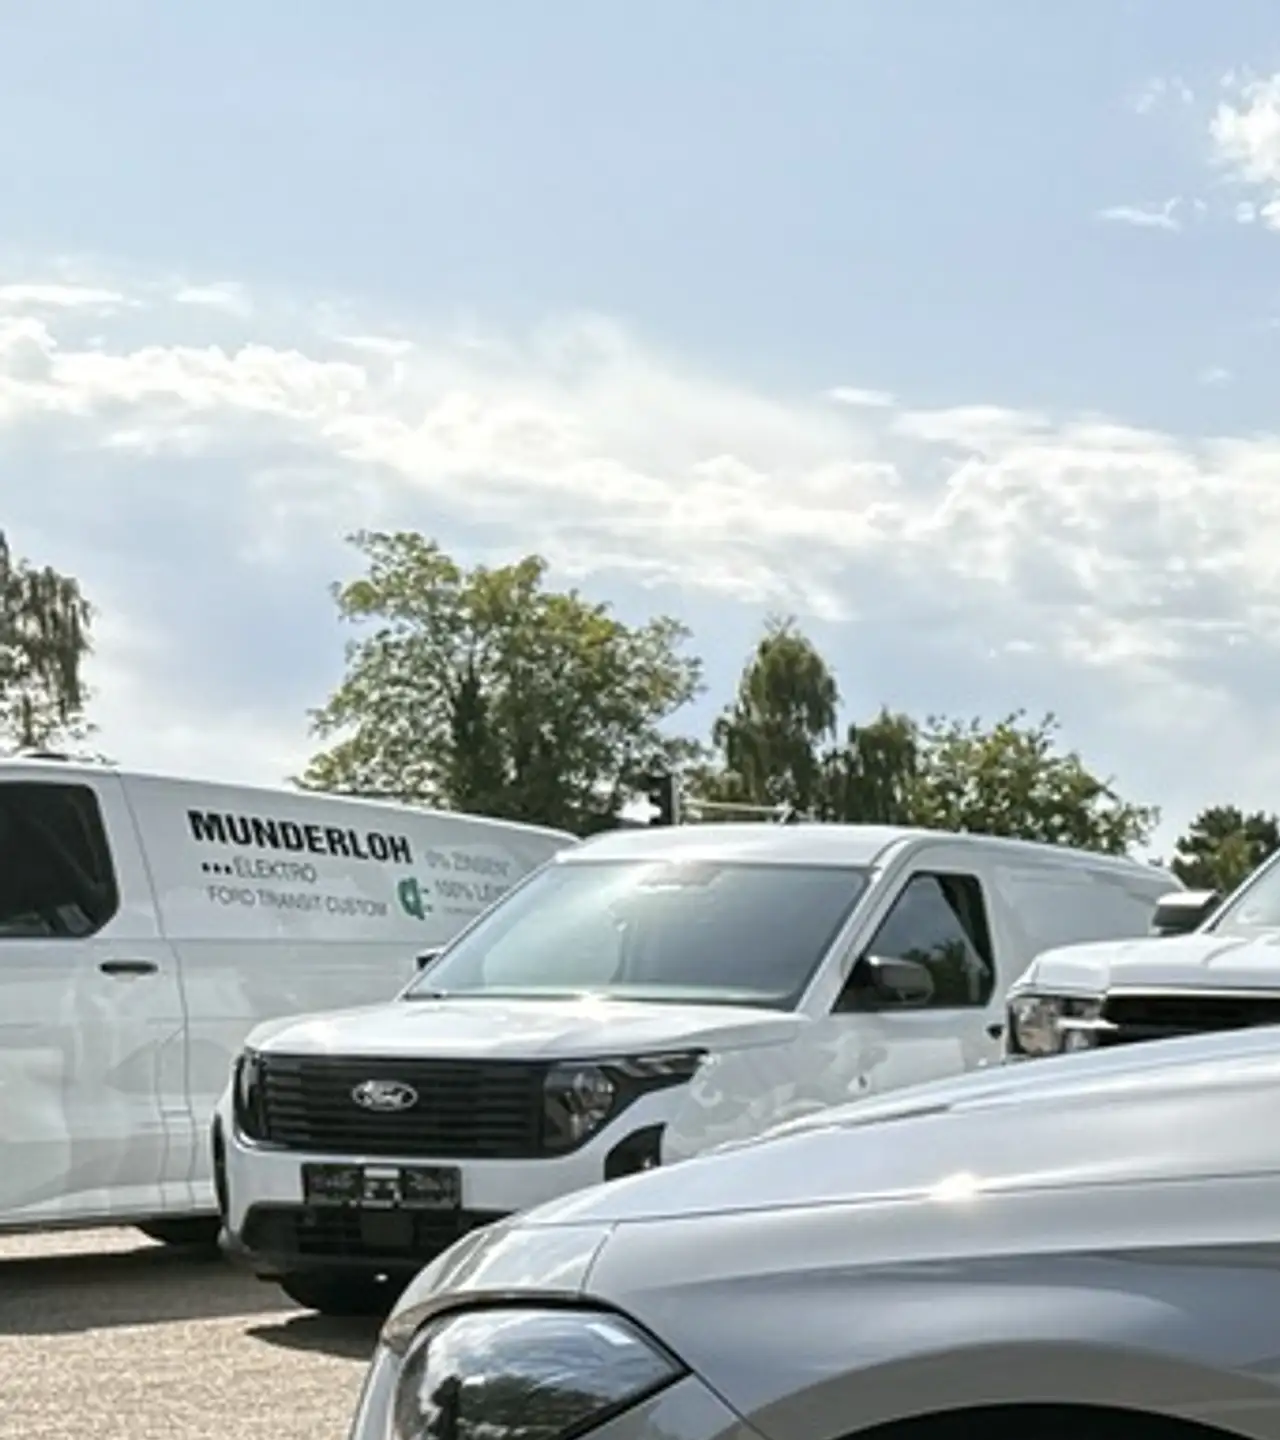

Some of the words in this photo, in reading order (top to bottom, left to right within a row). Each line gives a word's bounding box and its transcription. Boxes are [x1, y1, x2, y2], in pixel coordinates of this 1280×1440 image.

[187, 809, 413, 864] MUNDERLOH
[207, 885, 256, 907] FORD
[257, 889, 321, 911] TRANSIT
[326, 895, 388, 917] CUSTOM
